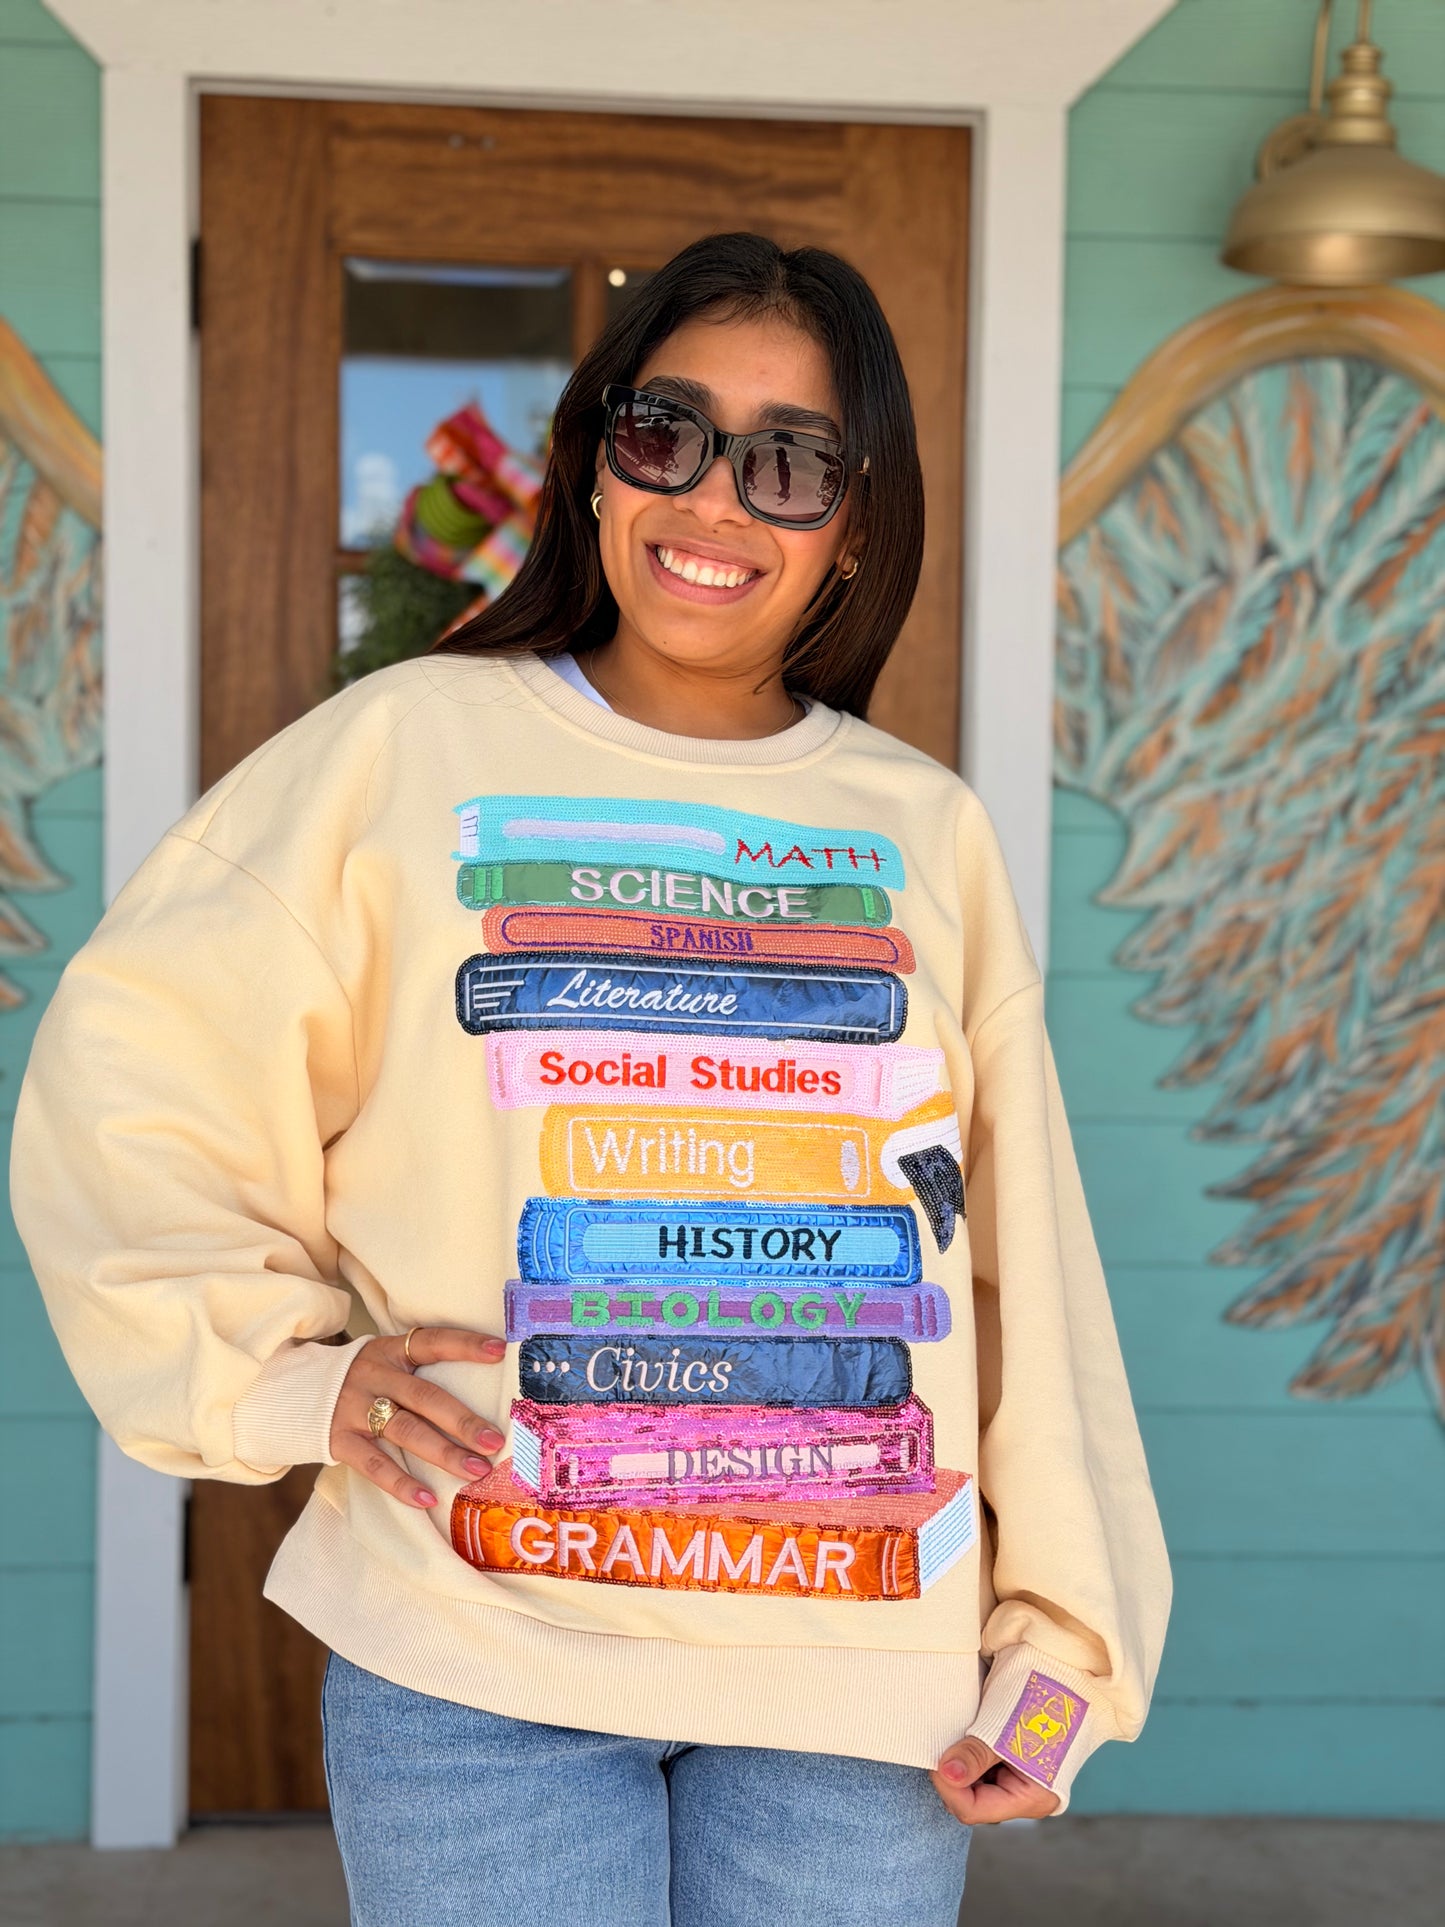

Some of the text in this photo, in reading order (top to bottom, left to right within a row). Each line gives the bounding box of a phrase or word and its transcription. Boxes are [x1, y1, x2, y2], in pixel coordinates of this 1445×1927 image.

[734, 839, 886, 872] MATH
[570, 867, 812, 918] SCIENCE
[650, 924, 753, 951] SPANISH
[547, 970, 739, 1015] Literature
[539, 1051, 842, 1096] Social Studies
[583, 1126, 755, 1187] Writing
[658, 1225, 842, 1263] HISTORY
[570, 1291, 867, 1330] BIOLOGY
[586, 1347, 733, 1393] Civics
[666, 1443, 834, 1485] DESIGN
[510, 1517, 856, 1591] GRAMMAR
